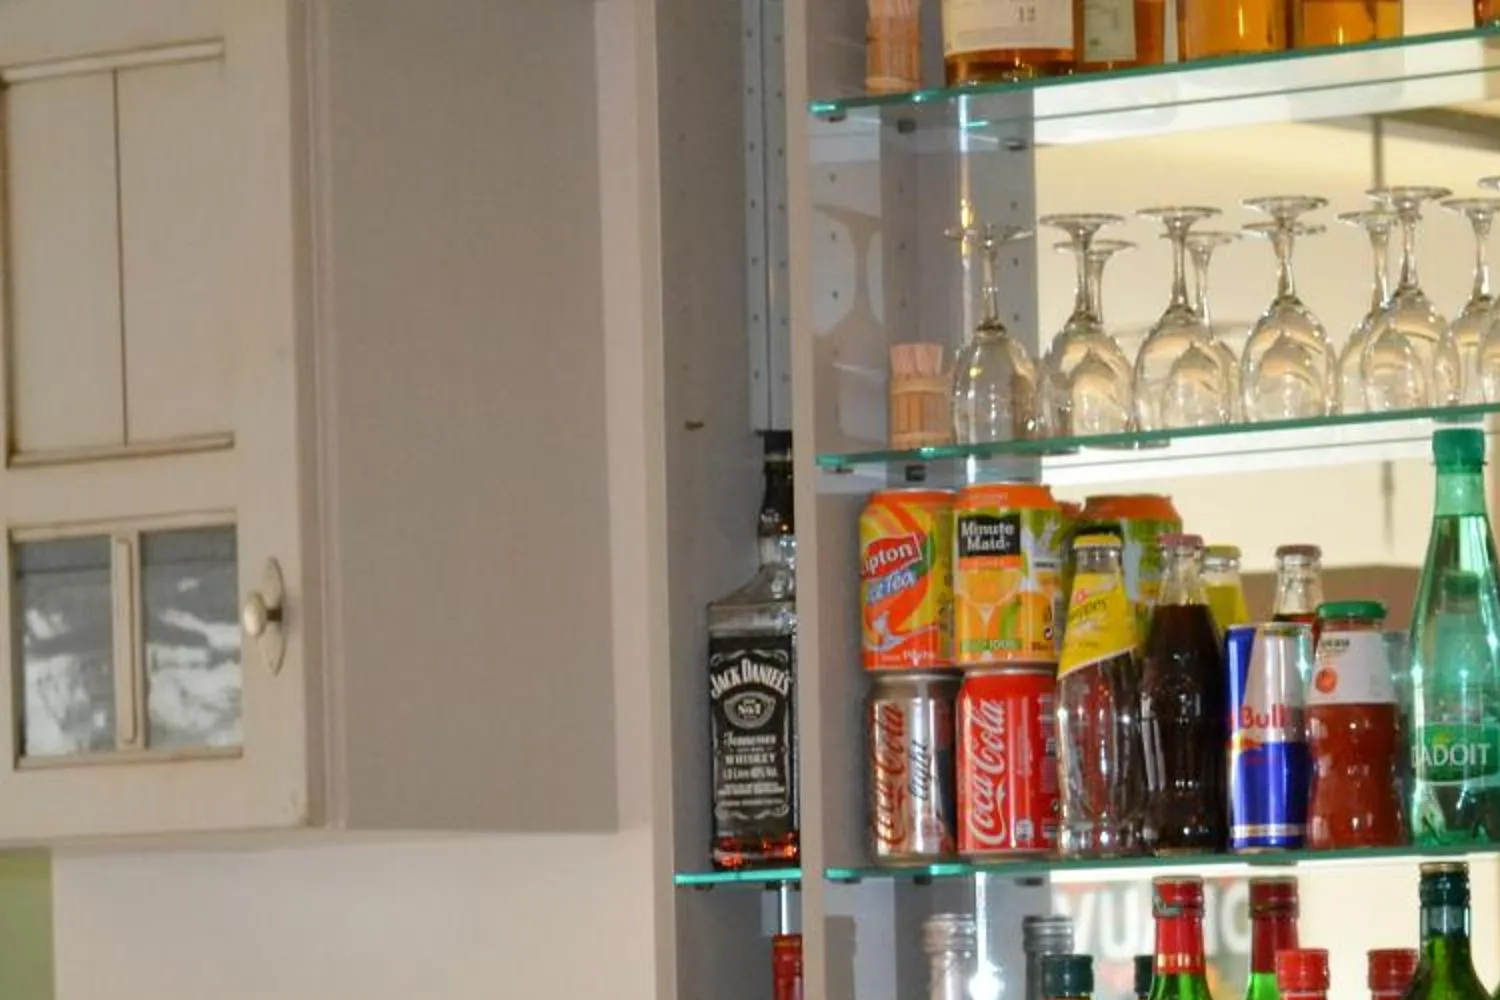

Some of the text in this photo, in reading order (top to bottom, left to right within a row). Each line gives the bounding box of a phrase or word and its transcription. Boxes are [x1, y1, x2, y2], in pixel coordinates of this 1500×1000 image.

[960, 520, 1016, 537] Minute
[966, 535, 1008, 552] Maid
[863, 541, 913, 575] ipton
[710, 658, 790, 699] JACK DANIEL'S
[1241, 703, 1290, 728] Bull
